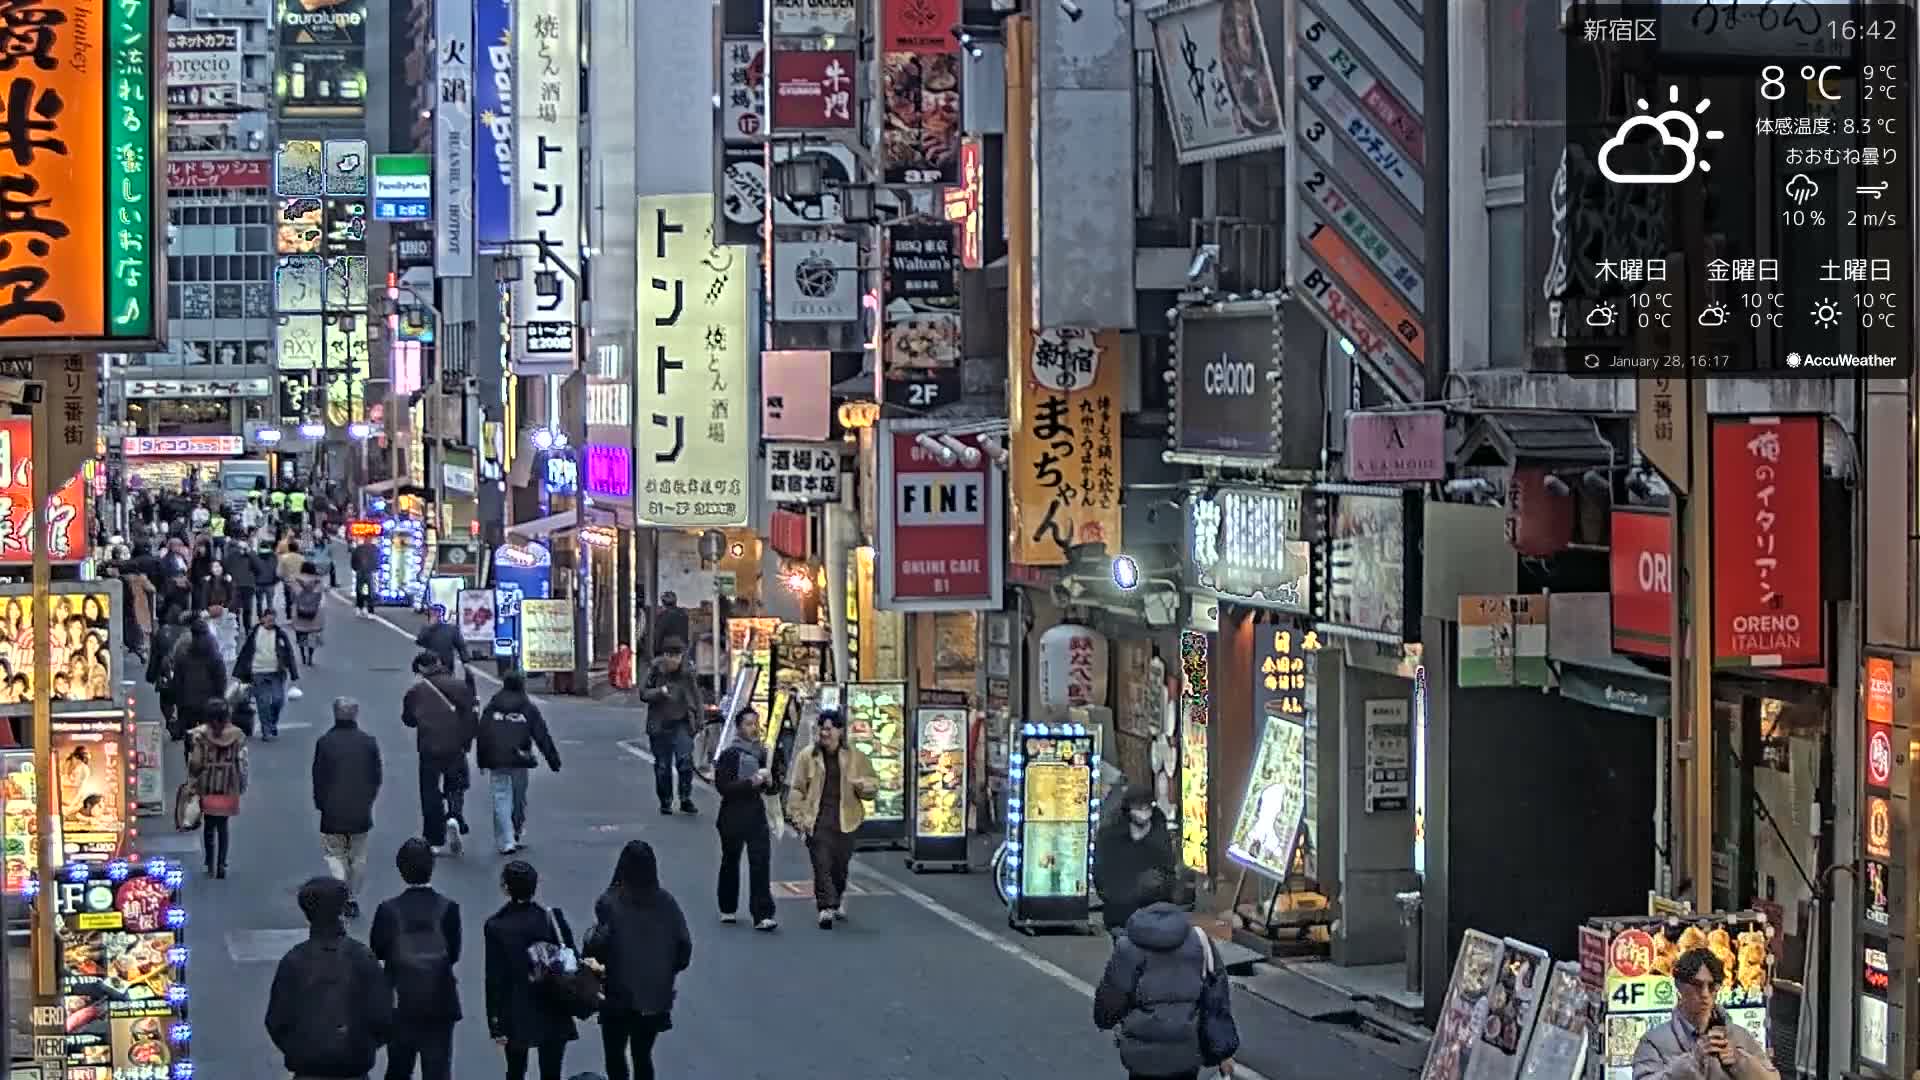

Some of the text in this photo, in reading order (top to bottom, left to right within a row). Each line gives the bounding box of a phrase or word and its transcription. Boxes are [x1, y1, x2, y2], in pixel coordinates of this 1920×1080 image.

[1306, 22, 1326, 42] 5
[168, 54, 230, 75] precio
[442, 40, 467, 104] 火鍋
[822, 59, 851, 119] 牛門
[1307, 75, 1326, 91] 4
[1307, 122, 1326, 142] 3
[1348, 119, 1405, 178] センチュリー
[168, 161, 260, 174] ルドラッシュ
[168, 175, 219, 185] ンバーグ
[1304, 172, 1326, 193] 2
[1304, 269, 1331, 298] B1
[652, 208, 684, 461] トントン
[1036, 339, 1094, 373] 新宿
[1056, 373, 1077, 387] の
[908, 384, 938, 405] 2F
[1653, 377, 1673, 441] り一番街
[771, 450, 836, 470] 酒場心
[1033, 396, 1078, 549] まっちゃん
[771, 475, 836, 493] 新宿本店
[903, 485, 978, 512] FINE
[1747, 430, 1781, 604] 俺のイタリアン
[902, 560, 981, 574] ONLINE CAFE
[1733, 615, 1800, 632] ORENO
[1733, 634, 1801, 651] ITALIAN
[1612, 983, 1646, 1005] 4F
